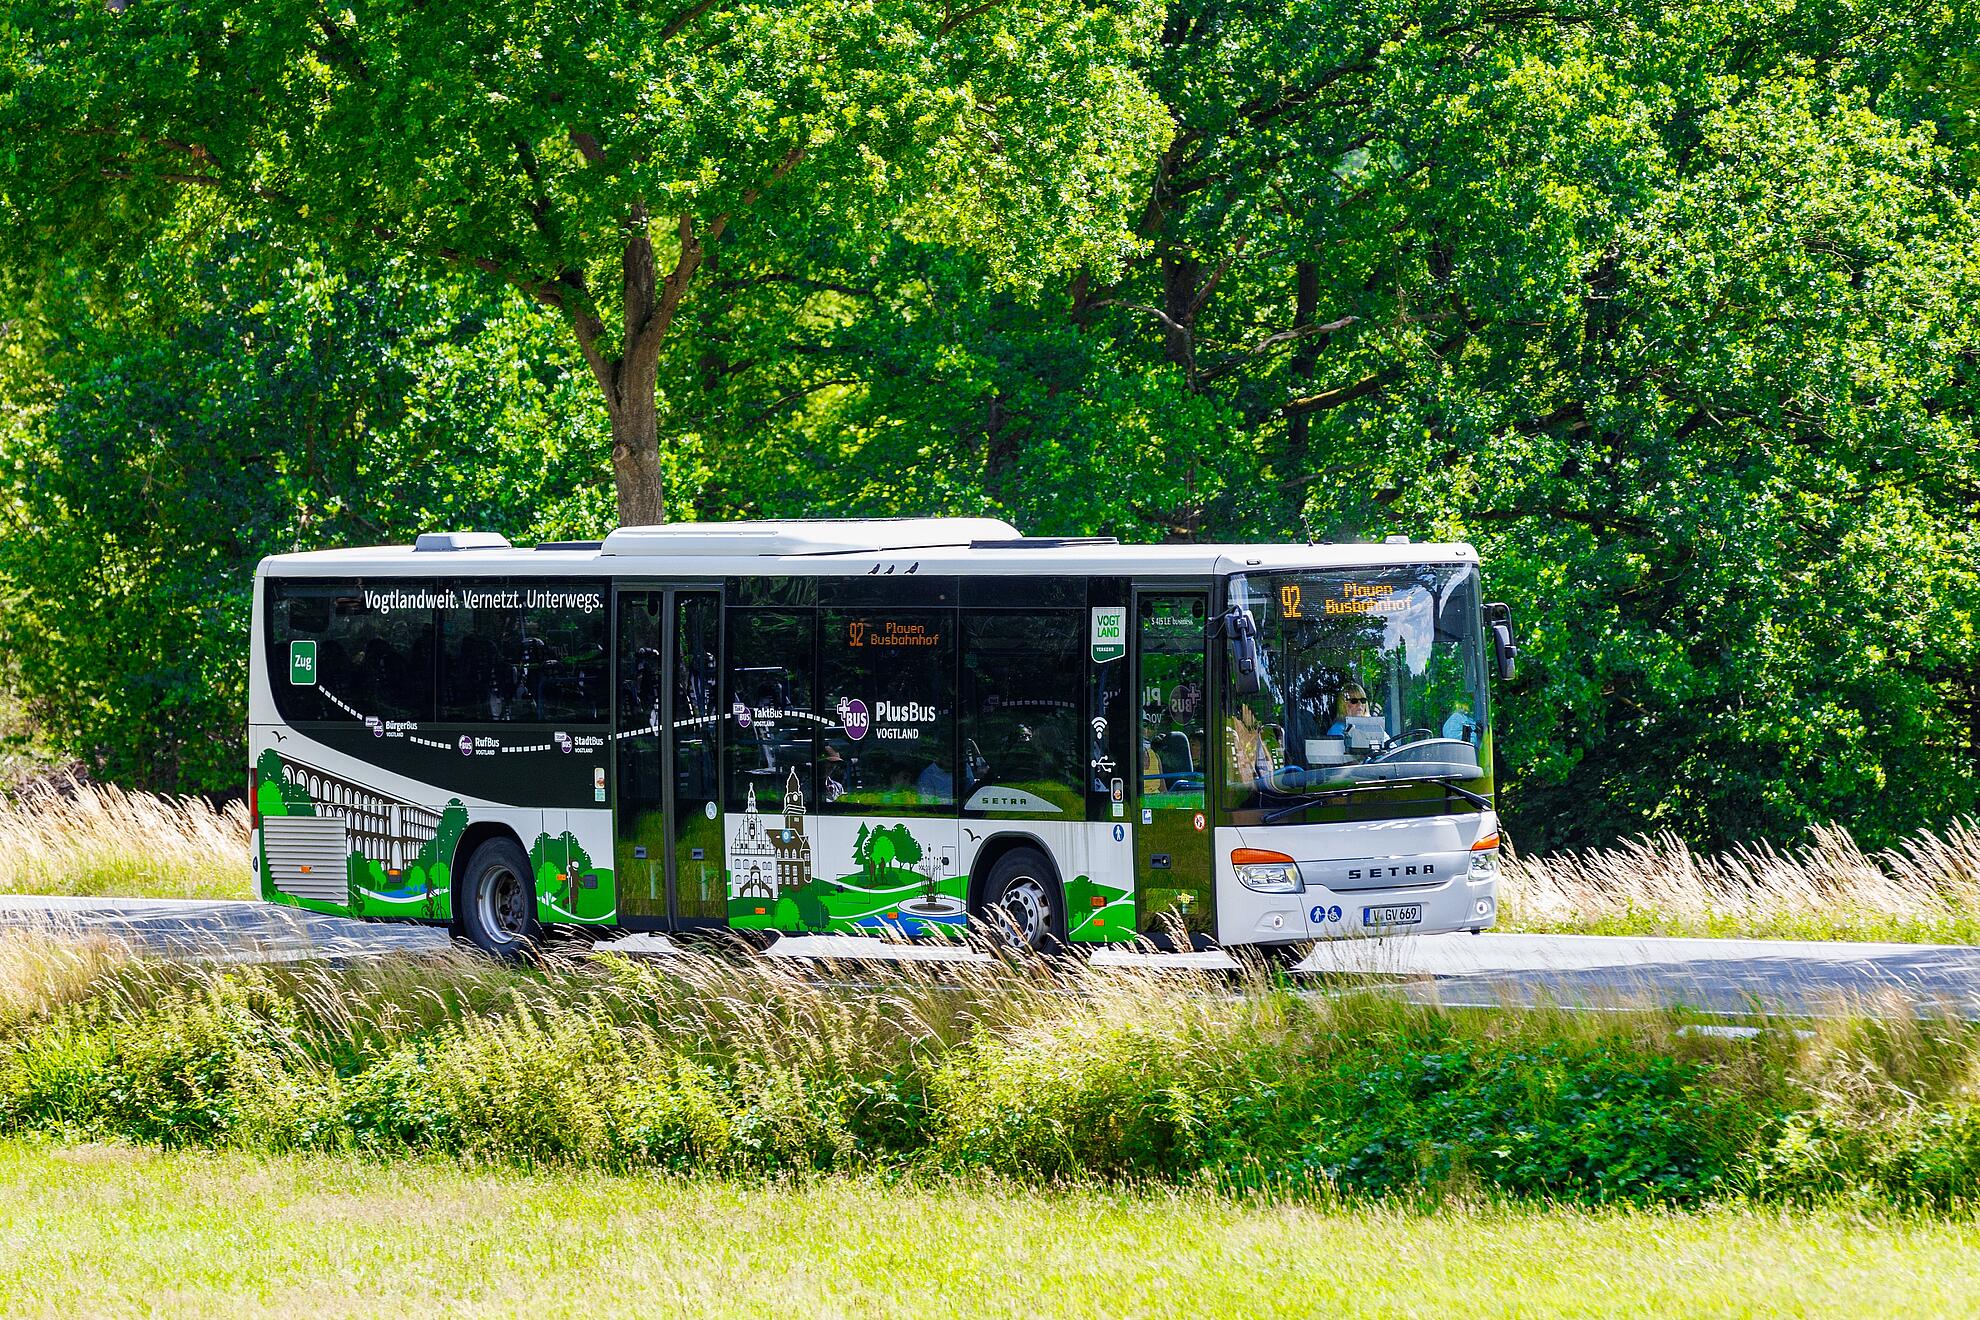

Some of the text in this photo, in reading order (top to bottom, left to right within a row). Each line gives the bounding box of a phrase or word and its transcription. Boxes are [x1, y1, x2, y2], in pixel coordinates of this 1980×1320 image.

[1343, 582, 1393, 597] Plauen
[364, 588, 603, 614] Vogtlandweit. Vernetzt. Unterwegs.
[1281, 586, 1302, 617] 92
[1325, 596, 1412, 614] Busbahnhof
[1097, 615, 1121, 626] VOGT
[1164, 616, 1172, 626] LE
[849, 622, 864, 647] 92
[885, 622, 925, 634] Plauen
[1097, 626, 1120, 638] LAND
[870, 633, 940, 646] Busbahnhof
[294, 654, 312, 671] Zug
[753, 707, 783, 719] TaktBus
[875, 700, 936, 722] PlusBus
[385, 720, 418, 732] BürgerBus
[846, 712, 867, 727] BUS
[875, 728, 919, 739] VOGTLAND
[475, 736, 500, 748] RufBus
[574, 735, 604, 746] StadtBus
[982, 797, 1027, 805] SETRA
[1348, 864, 1434, 880] SETRA
[1385, 908, 1398, 921] GV
[1399, 907, 1417, 920] 669
